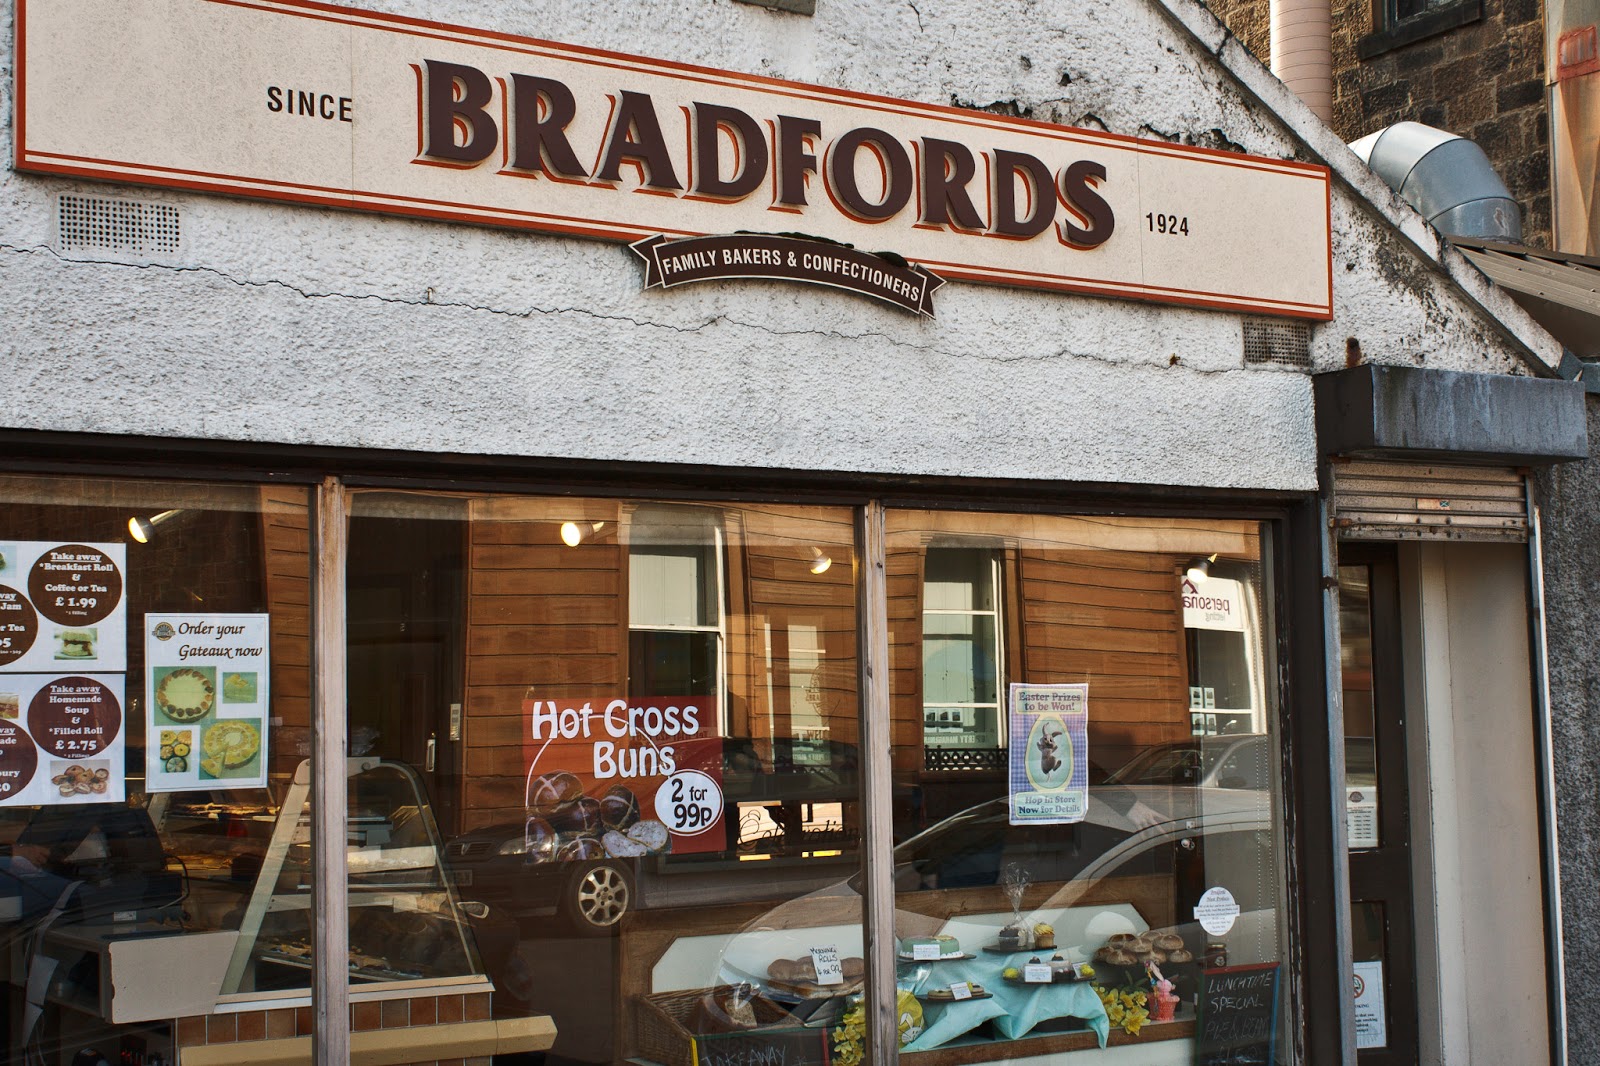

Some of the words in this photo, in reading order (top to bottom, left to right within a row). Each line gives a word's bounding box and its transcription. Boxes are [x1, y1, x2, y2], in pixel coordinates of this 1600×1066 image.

[266, 86, 352, 122] SINCE
[409, 58, 1115, 251] BRADFORDS
[1146, 212, 1189, 236] 1924
[662, 250, 716, 275] FAMILY
[723, 248, 781, 266] BAKERS
[787, 254, 797, 267] &
[803, 253, 920, 302] CONFECTIONERS
[50, 552, 74, 560] Take
[76, 553, 102, 562] away
[93, 563, 113, 571] Roll
[45, 584, 76, 592] Coffee
[90, 584, 107, 592] Tea
[1, 602, 22, 610] Jam
[55, 597, 64, 607] £
[67, 597, 97, 608] 1.99
[178, 621, 214, 635] Order
[215, 625, 245, 640] your
[179, 644, 234, 660] Gateaux
[235, 647, 262, 656] now
[50, 685, 74, 693] Take
[76, 686, 101, 694] away
[1018, 691, 1053, 701] Easter
[1052, 692, 1081, 701] Prizes
[64, 706, 89, 715] Soup
[1024, 702, 1035, 710] to
[1037, 702, 1049, 710] be
[1051, 702, 1075, 711] Won!
[532, 700, 593, 739] Hot
[603, 699, 700, 739] Cross
[83, 727, 103, 735] Roll
[55, 740, 64, 750] £
[67, 740, 97, 750] 2.75
[593, 740, 676, 779] Buns
[671, 778, 684, 803] 2
[689, 785, 707, 801] for
[1025, 796, 1042, 805] Hop
[1055, 795, 1076, 804] Store
[1018, 806, 1038, 814] Now
[1040, 805, 1053, 813] for
[1055, 804, 1080, 813] Details
[673, 803, 713, 828] 99p
[1208, 971, 1273, 994] LUNCHTIME
[1211, 994, 1264, 1014] SPECIAL
